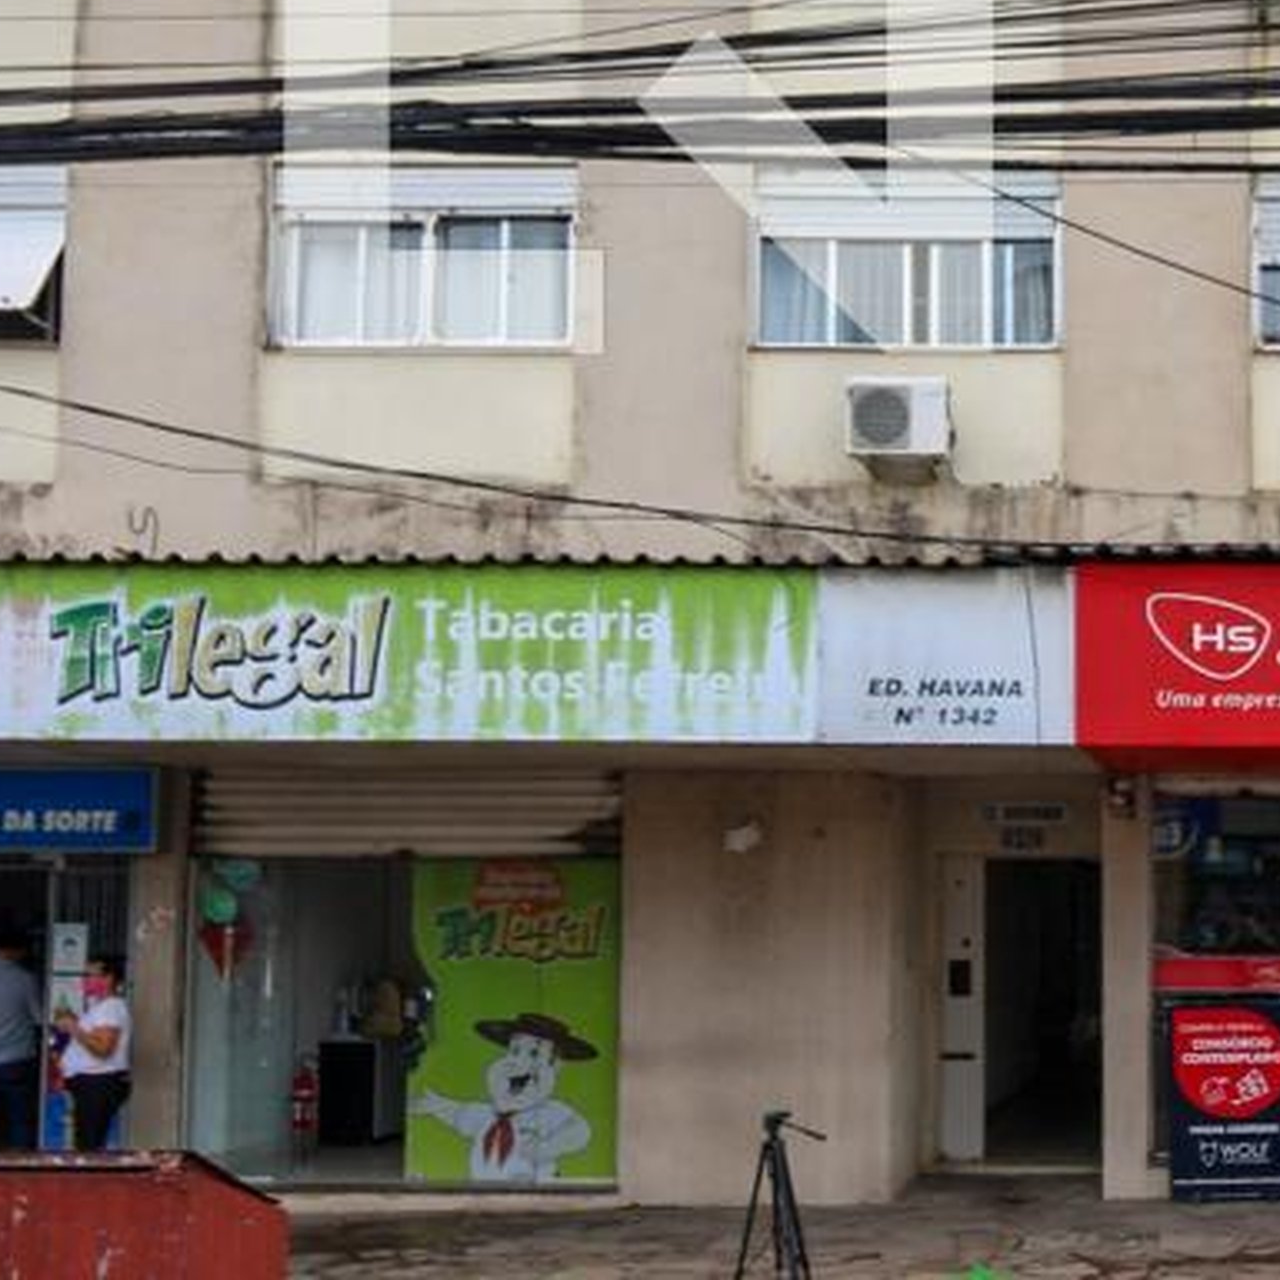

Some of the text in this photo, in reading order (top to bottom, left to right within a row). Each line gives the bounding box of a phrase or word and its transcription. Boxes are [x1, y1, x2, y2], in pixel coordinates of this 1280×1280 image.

[415, 599, 662, 641] Tabacaria
[1192, 623, 1258, 652] HS
[50, 596, 391, 710] Trilegal
[868, 678, 1024, 697] ED. HAVANA
[1156, 690, 1205, 708] Uma
[937, 707, 999, 725] 1342
[40, 809, 118, 832] SORTE
